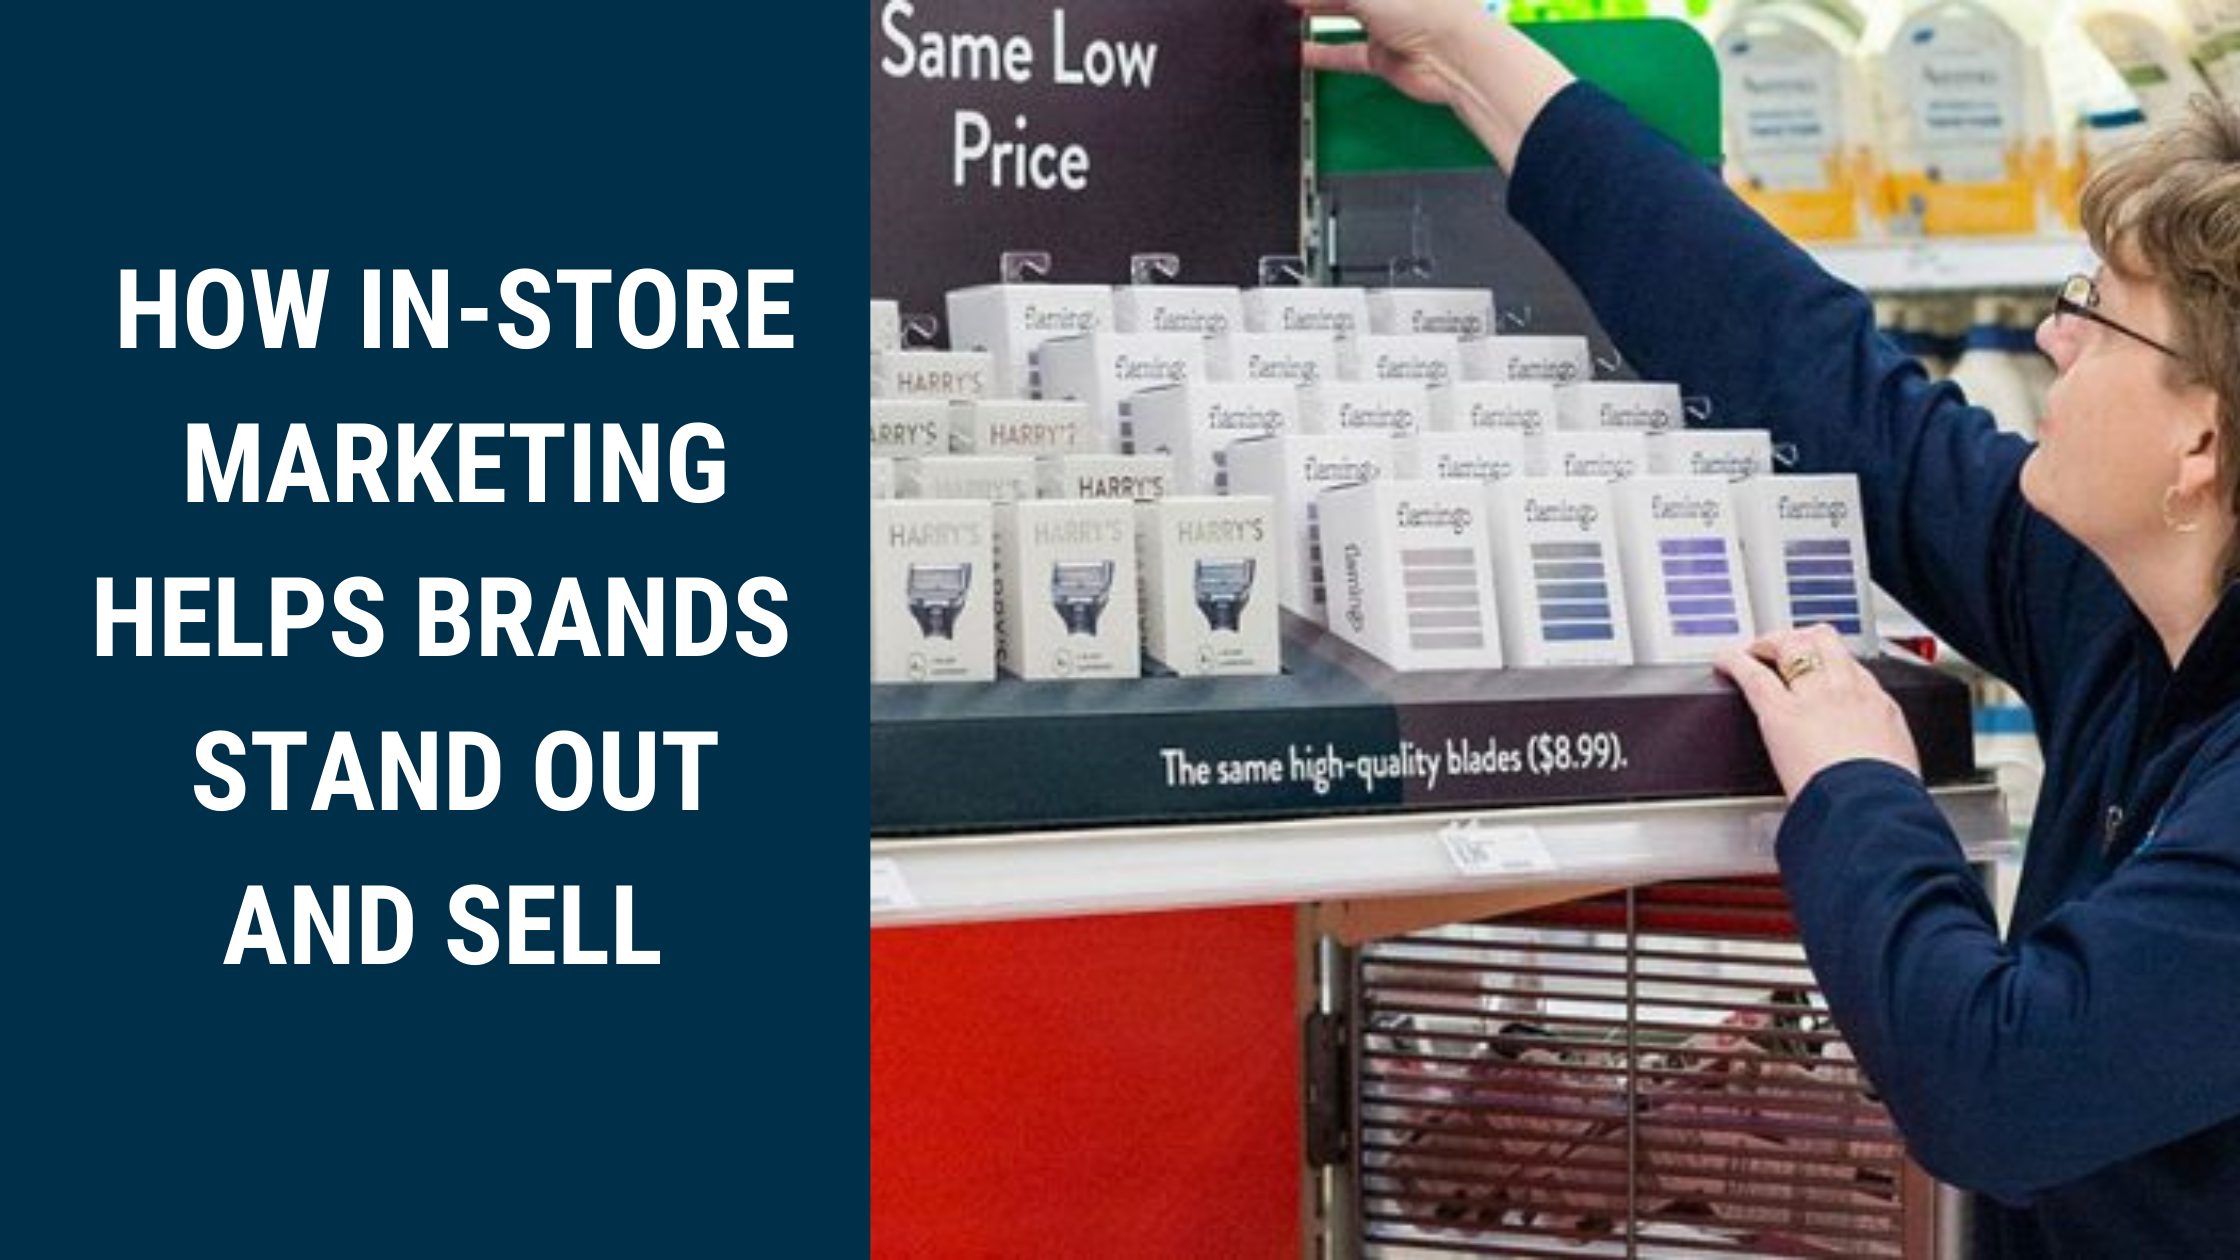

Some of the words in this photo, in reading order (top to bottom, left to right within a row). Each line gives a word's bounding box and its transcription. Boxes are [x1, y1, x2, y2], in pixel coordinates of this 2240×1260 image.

[881, 0, 1033, 83] Same
[1053, 8, 1157, 87] Low
[954, 110, 1090, 190] Price
[1025, 305, 1099, 332] flaming
[898, 371, 983, 394] HARRY'S
[1079, 476, 1165, 498] HARRY'S
[1396, 502, 1473, 534] flamingo
[1524, 499, 1599, 530] flamingo
[1652, 496, 1720, 527] flamingo
[1779, 496, 1848, 528] flamingo
[889, 522, 983, 548] HARRY'S
[1034, 518, 1123, 546] HARRY'S
[1178, 517, 1264, 544] HARRY'S
[1344, 543, 1365, 633] flamingo
[1161, 749, 1210, 786] The
[1217, 758, 1283, 785] same
[1290, 742, 1441, 794] high-quality
[1446, 738, 1522, 775] blades
[1528, 732, 1628, 774] ($8.99).
